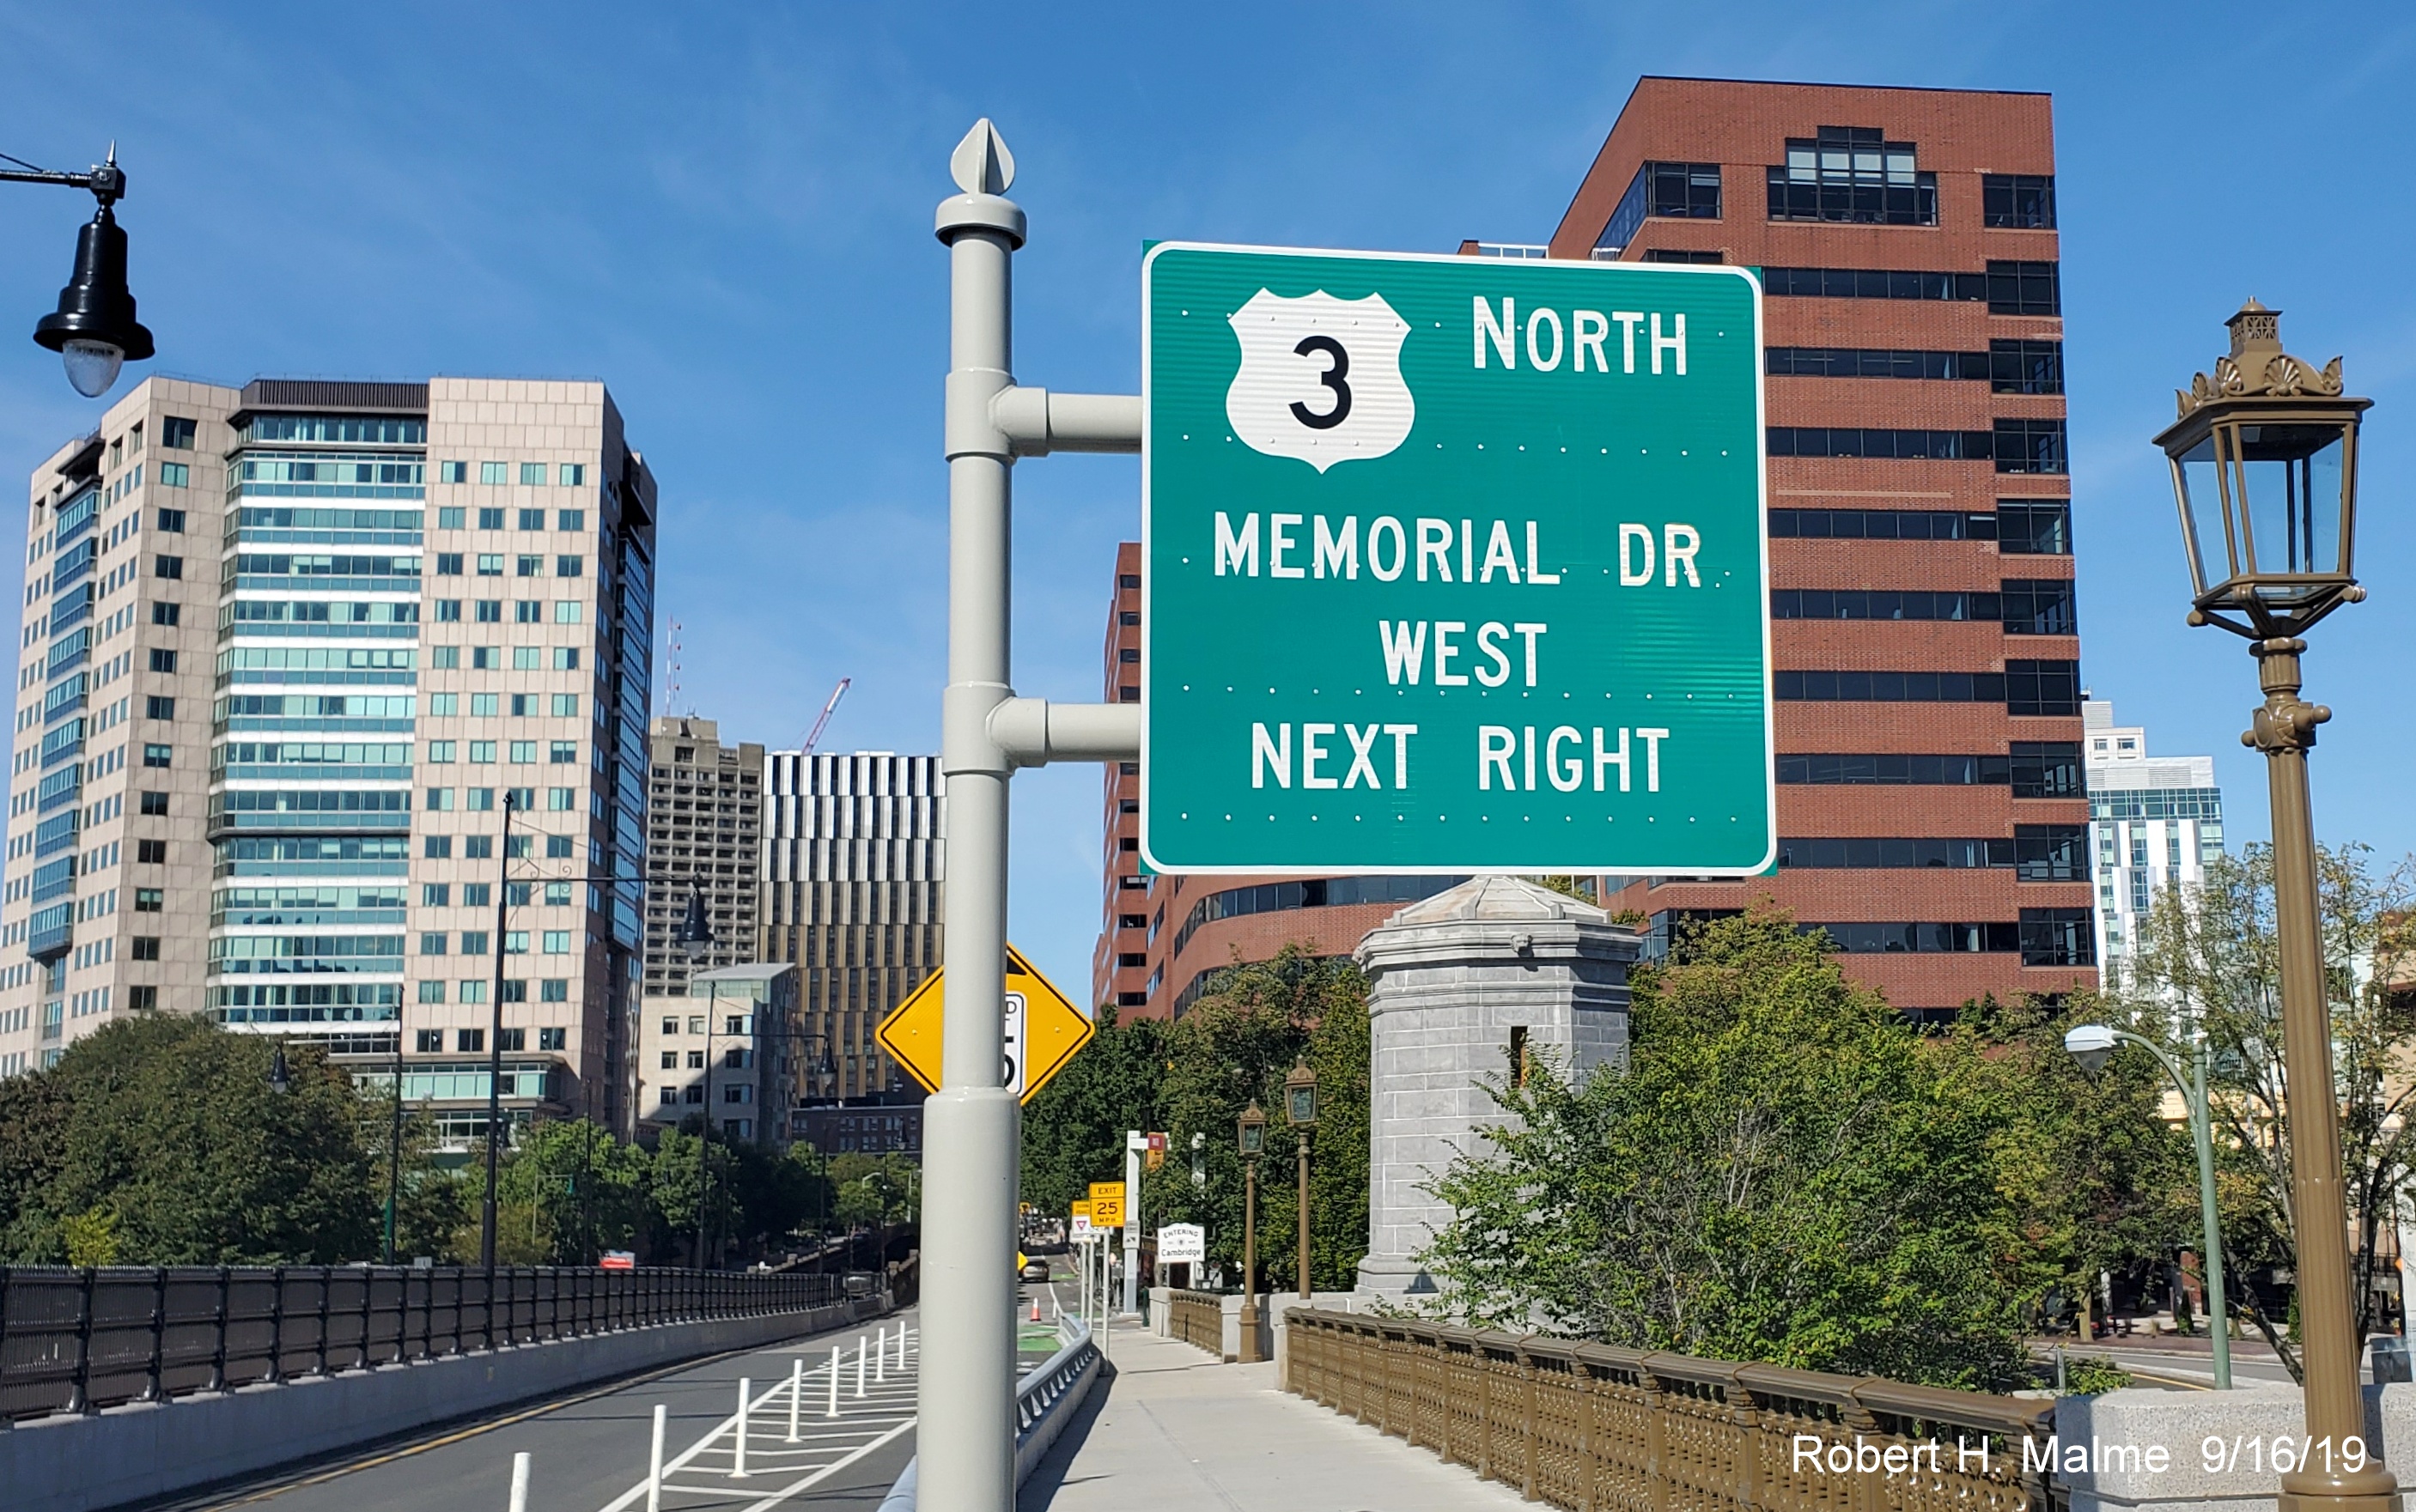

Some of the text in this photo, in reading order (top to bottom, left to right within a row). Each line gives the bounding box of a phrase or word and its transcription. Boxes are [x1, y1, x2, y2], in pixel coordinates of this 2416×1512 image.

[1473, 295, 1687, 375] NORTH
[1288, 335, 1352, 430] 3
[1214, 511, 1701, 587] MEMORIAL DR
[1378, 620, 1547, 688] WEST
[1251, 722, 1670, 792] NEXT RIGHT
[1097, 1202, 1118, 1215] 25
[1098, 1187, 1117, 1195] EXIT
[1161, 1248, 1202, 1258] Cambridge
[1163, 1229, 1199, 1239] ENTERING
